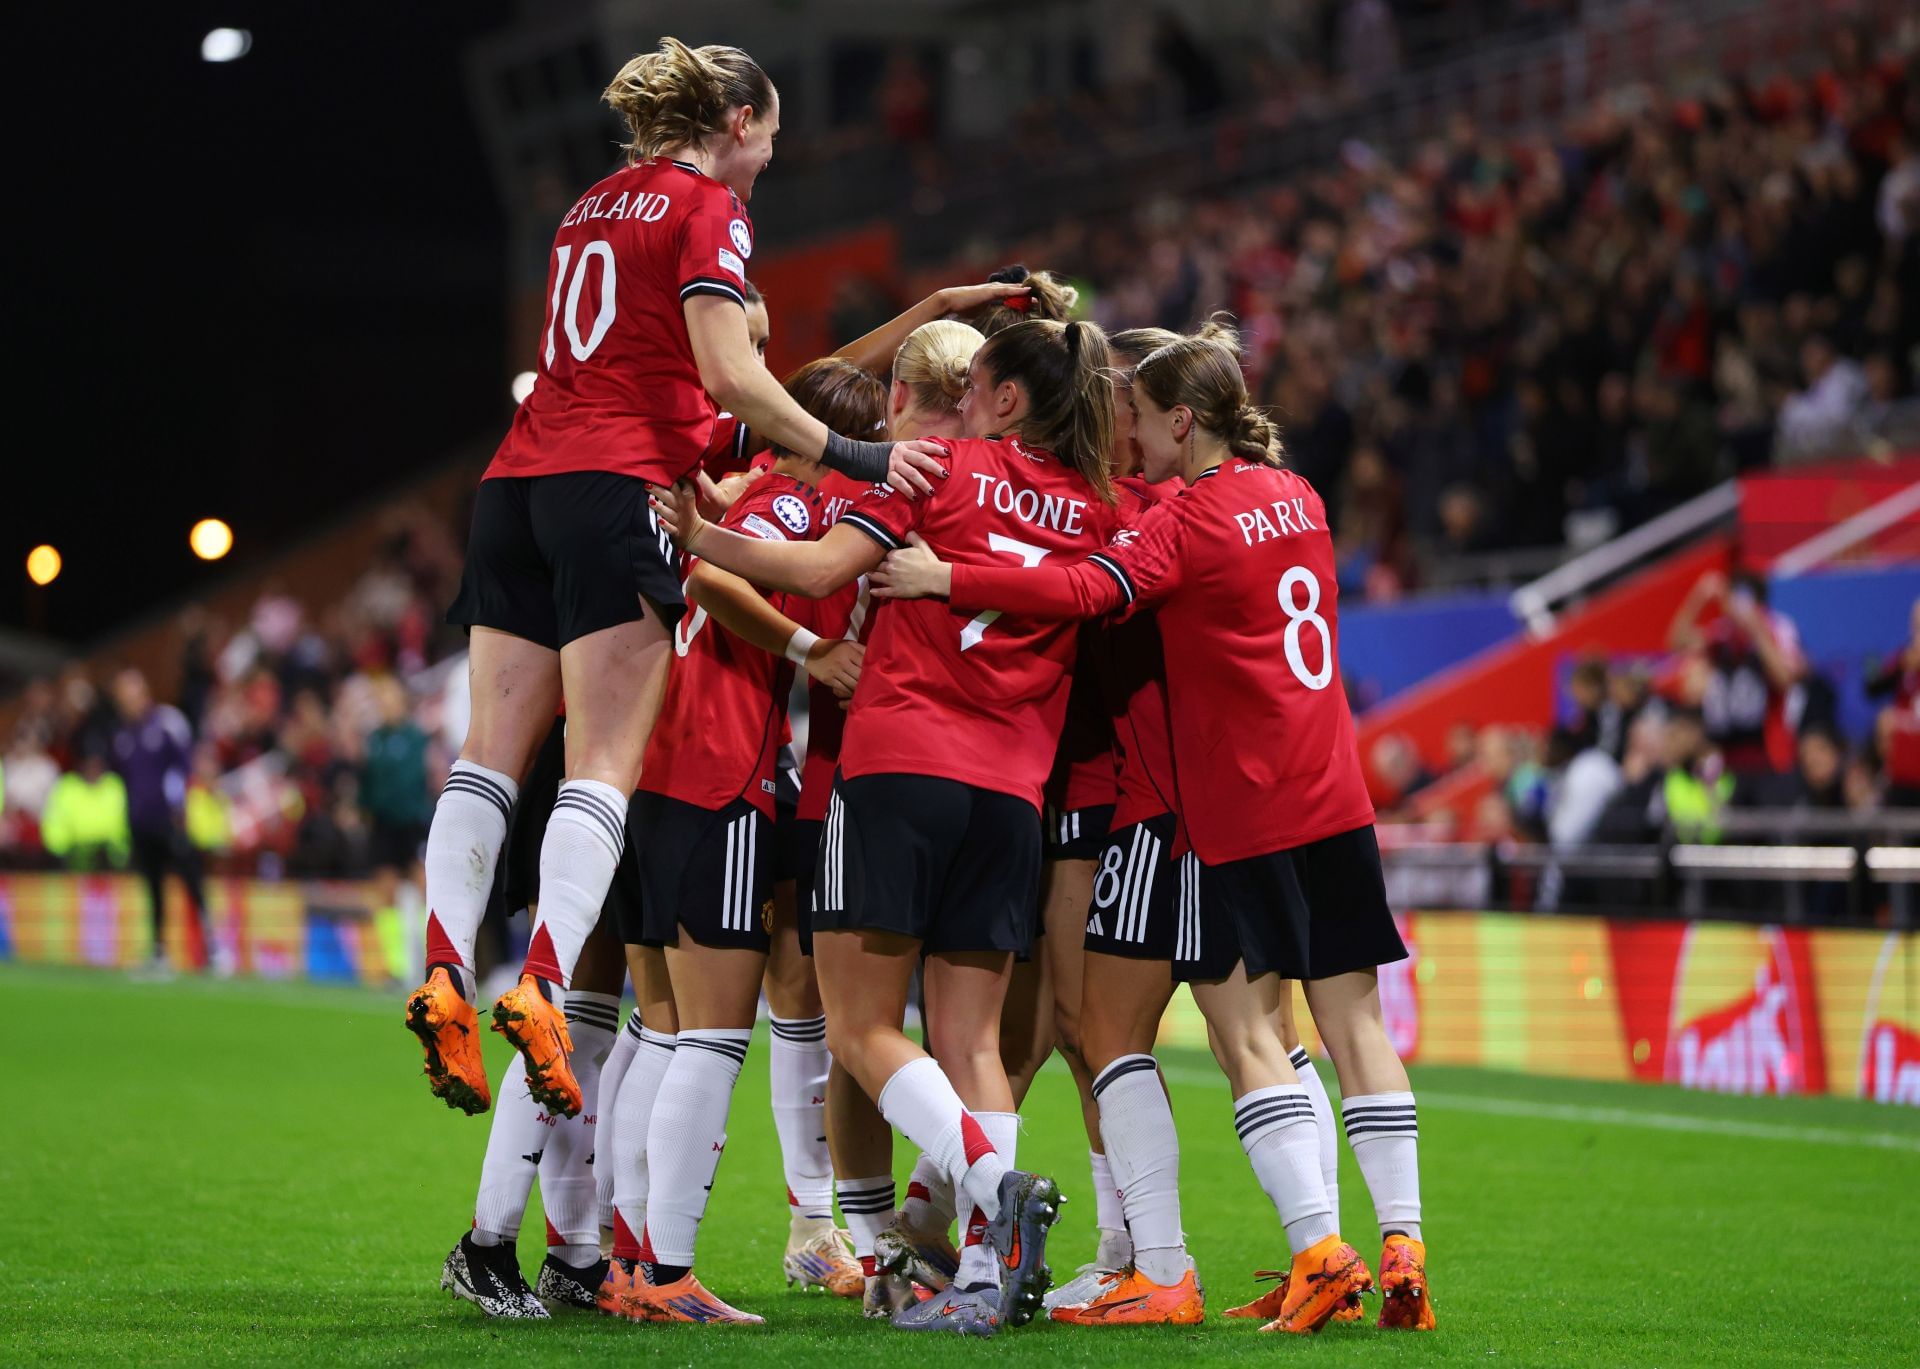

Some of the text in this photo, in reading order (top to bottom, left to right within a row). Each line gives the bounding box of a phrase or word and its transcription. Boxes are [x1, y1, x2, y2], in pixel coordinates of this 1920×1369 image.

[560, 191, 670, 228] ERLAND
[545, 240, 617, 371] 10
[971, 472, 1087, 535] TOONE
[1233, 498, 1318, 547] PARK
[960, 531, 1053, 652] 7
[1277, 566, 1333, 690] 8
[1094, 844, 1123, 908] 8
